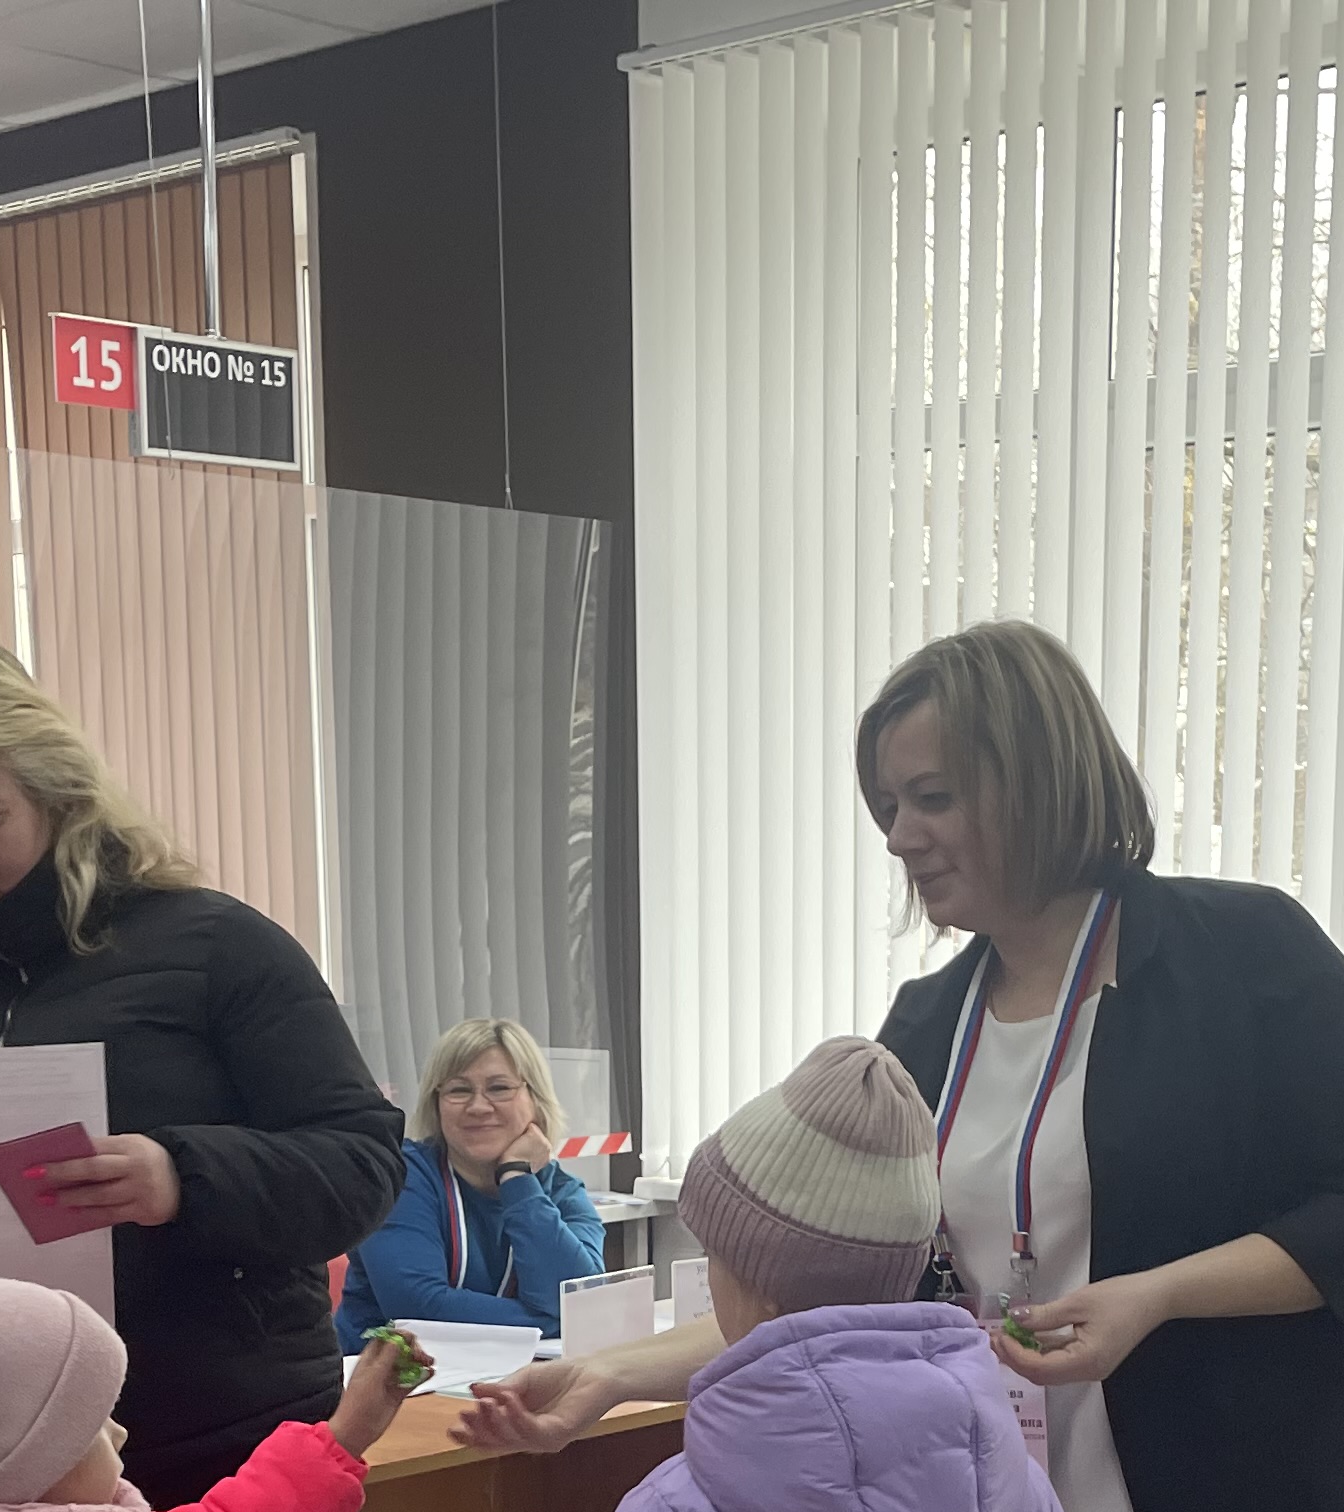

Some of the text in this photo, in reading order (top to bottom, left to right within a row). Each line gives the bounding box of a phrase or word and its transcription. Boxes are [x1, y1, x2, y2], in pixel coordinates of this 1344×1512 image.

[69, 335, 123, 392] 15
[151, 343, 287, 387] ОКНО № 15
